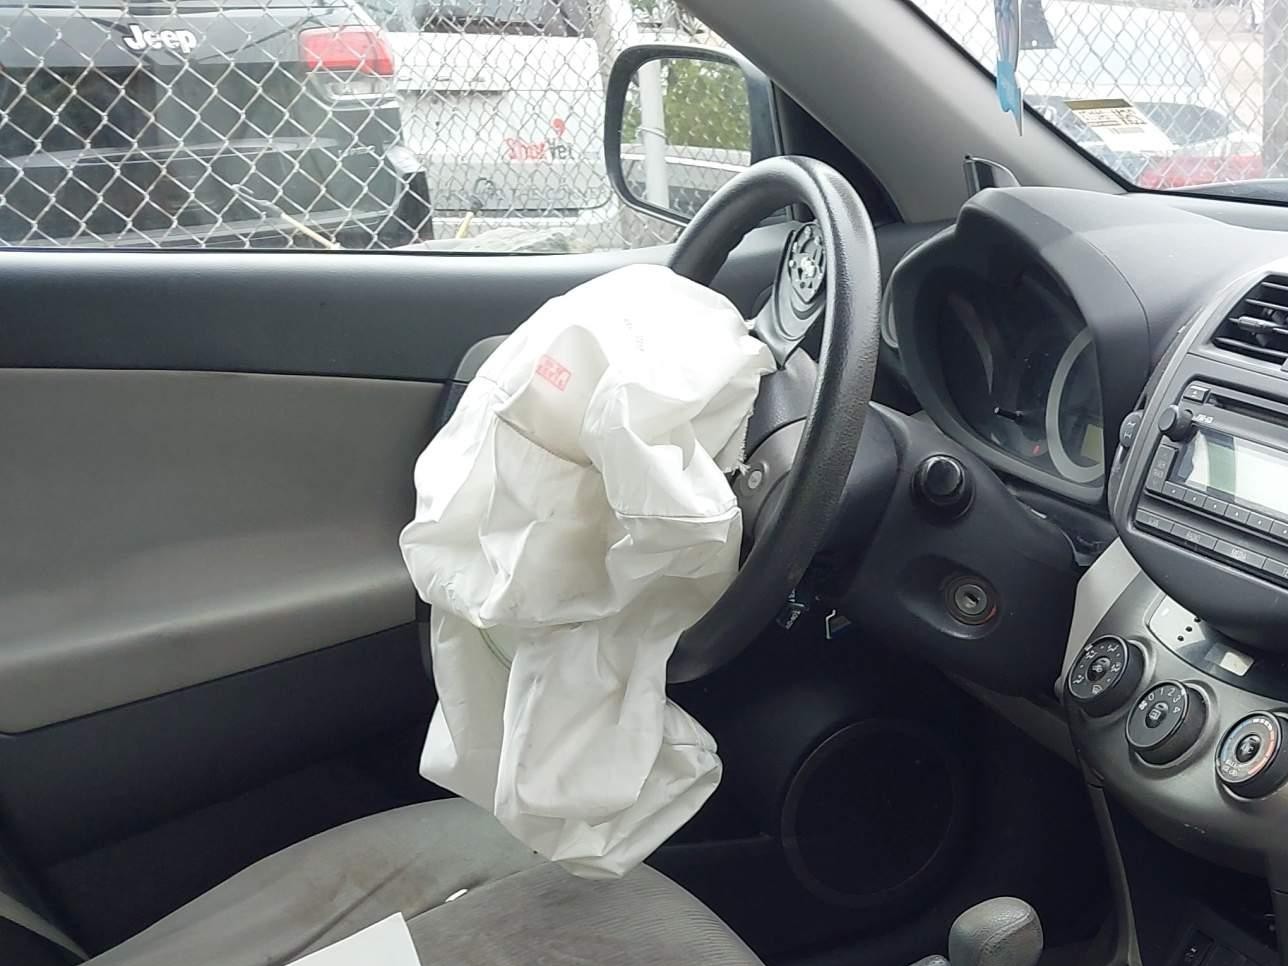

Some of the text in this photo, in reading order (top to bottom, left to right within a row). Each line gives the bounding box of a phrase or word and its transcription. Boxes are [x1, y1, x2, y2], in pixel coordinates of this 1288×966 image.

[123, 24, 197, 53] Jeep
[1148, 693, 1155, 701] 0
[1167, 687, 1176, 697] 2
[1172, 694, 1182, 703] 3
